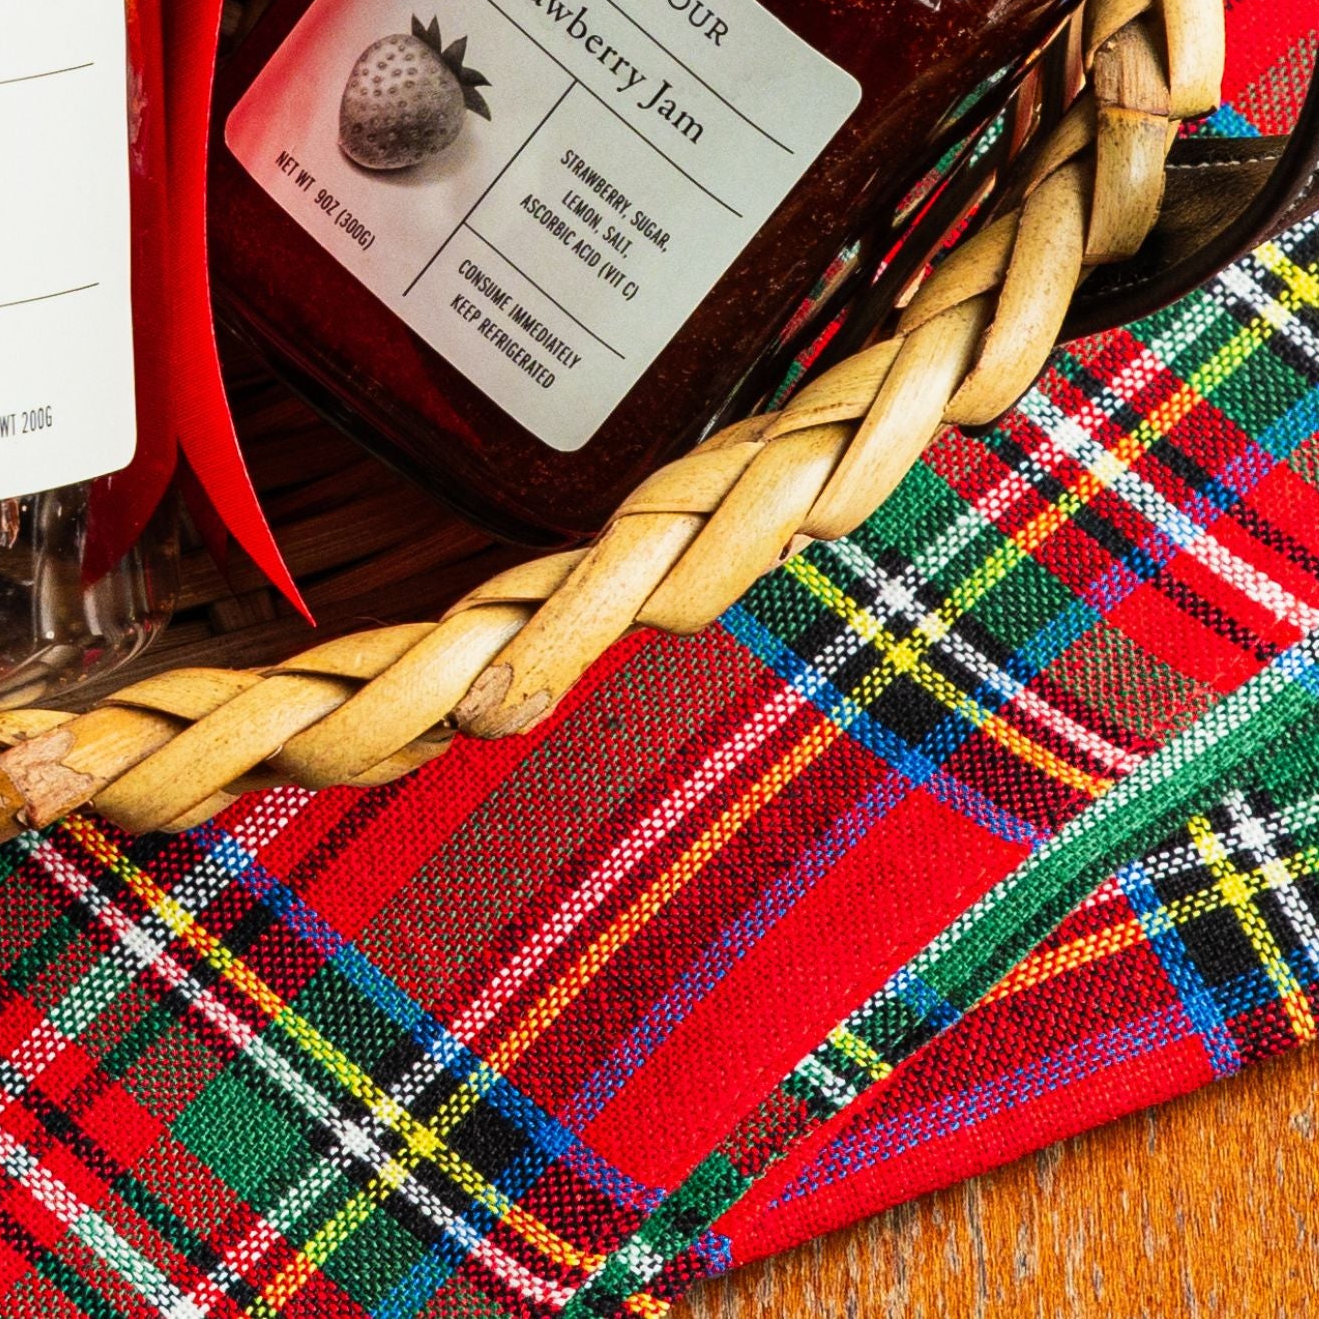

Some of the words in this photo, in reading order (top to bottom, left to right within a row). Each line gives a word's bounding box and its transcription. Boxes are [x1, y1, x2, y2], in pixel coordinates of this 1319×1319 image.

[637, 79, 704, 145] Jam
[274, 150, 298, 175] NET
[296, 172, 316, 193] WT
[335, 209, 376, 251] (300G)
[519, 193, 573, 247] ASCORBIC
[571, 238, 601, 270] ACID
[597, 261, 626, 289] (VIT
[620, 280, 640, 301] C)
[560, 149, 631, 219] STRAWBERRY,
[629, 210, 671, 253] SUGAR,
[561, 190, 600, 234] LEMON,
[602, 227, 633, 259] SALT,
[450, 294, 480, 324] KEEP
[477, 318, 556, 390] REFRIGERATED
[458, 259, 514, 312] CONSUME
[508, 303, 582, 371] IMMEDIATELY
[21, 405, 53, 437] 200G
